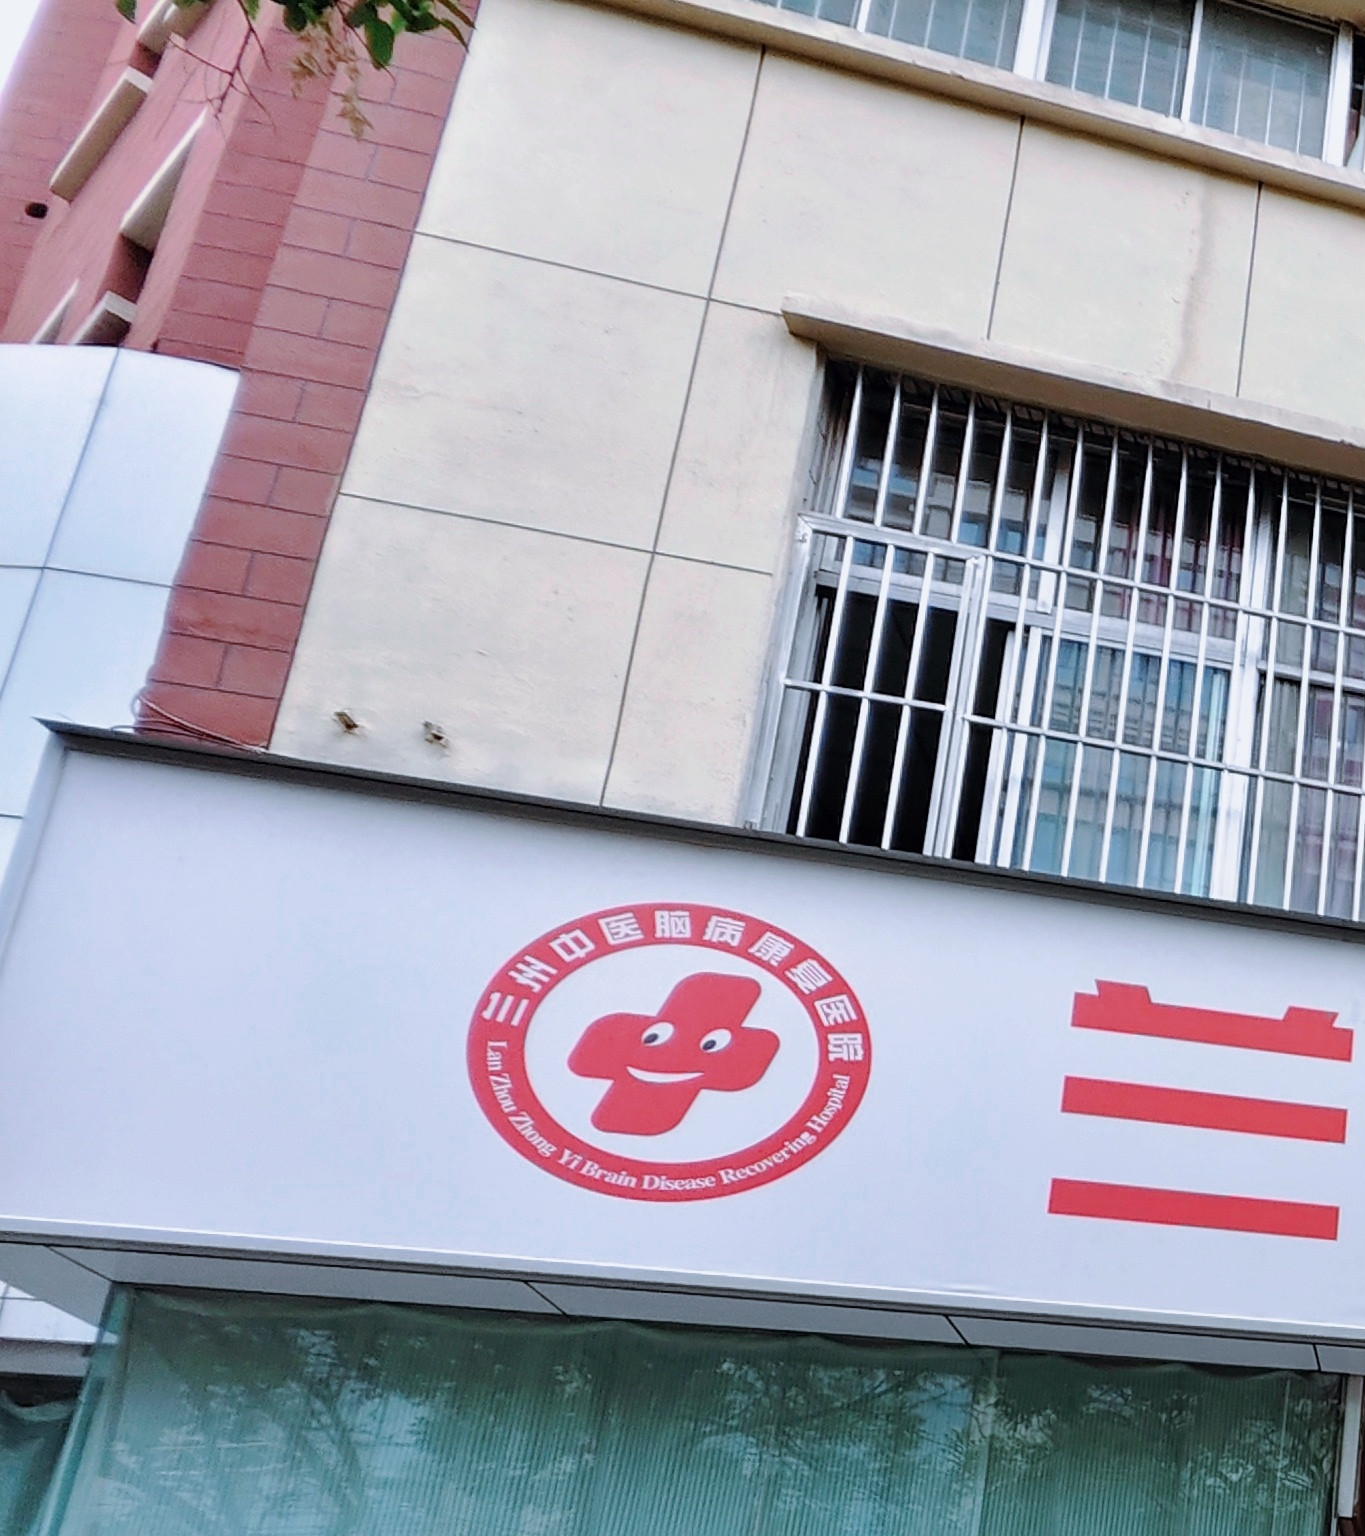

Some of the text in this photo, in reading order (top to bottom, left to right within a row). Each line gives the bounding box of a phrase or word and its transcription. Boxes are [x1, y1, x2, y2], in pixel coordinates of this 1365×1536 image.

[482, 909, 867, 1063] 兰州中医脑病康复医院
[487, 1040, 508, 1071] Lan
[488, 1073, 516, 1113] Zhou
[807, 1073, 851, 1134] Hospital
[508, 1112, 557, 1158] Zhong
[583, 1157, 638, 1189] Brain
[718, 1130, 819, 1184] Recovering
[641, 1173, 716, 1192] Disease
